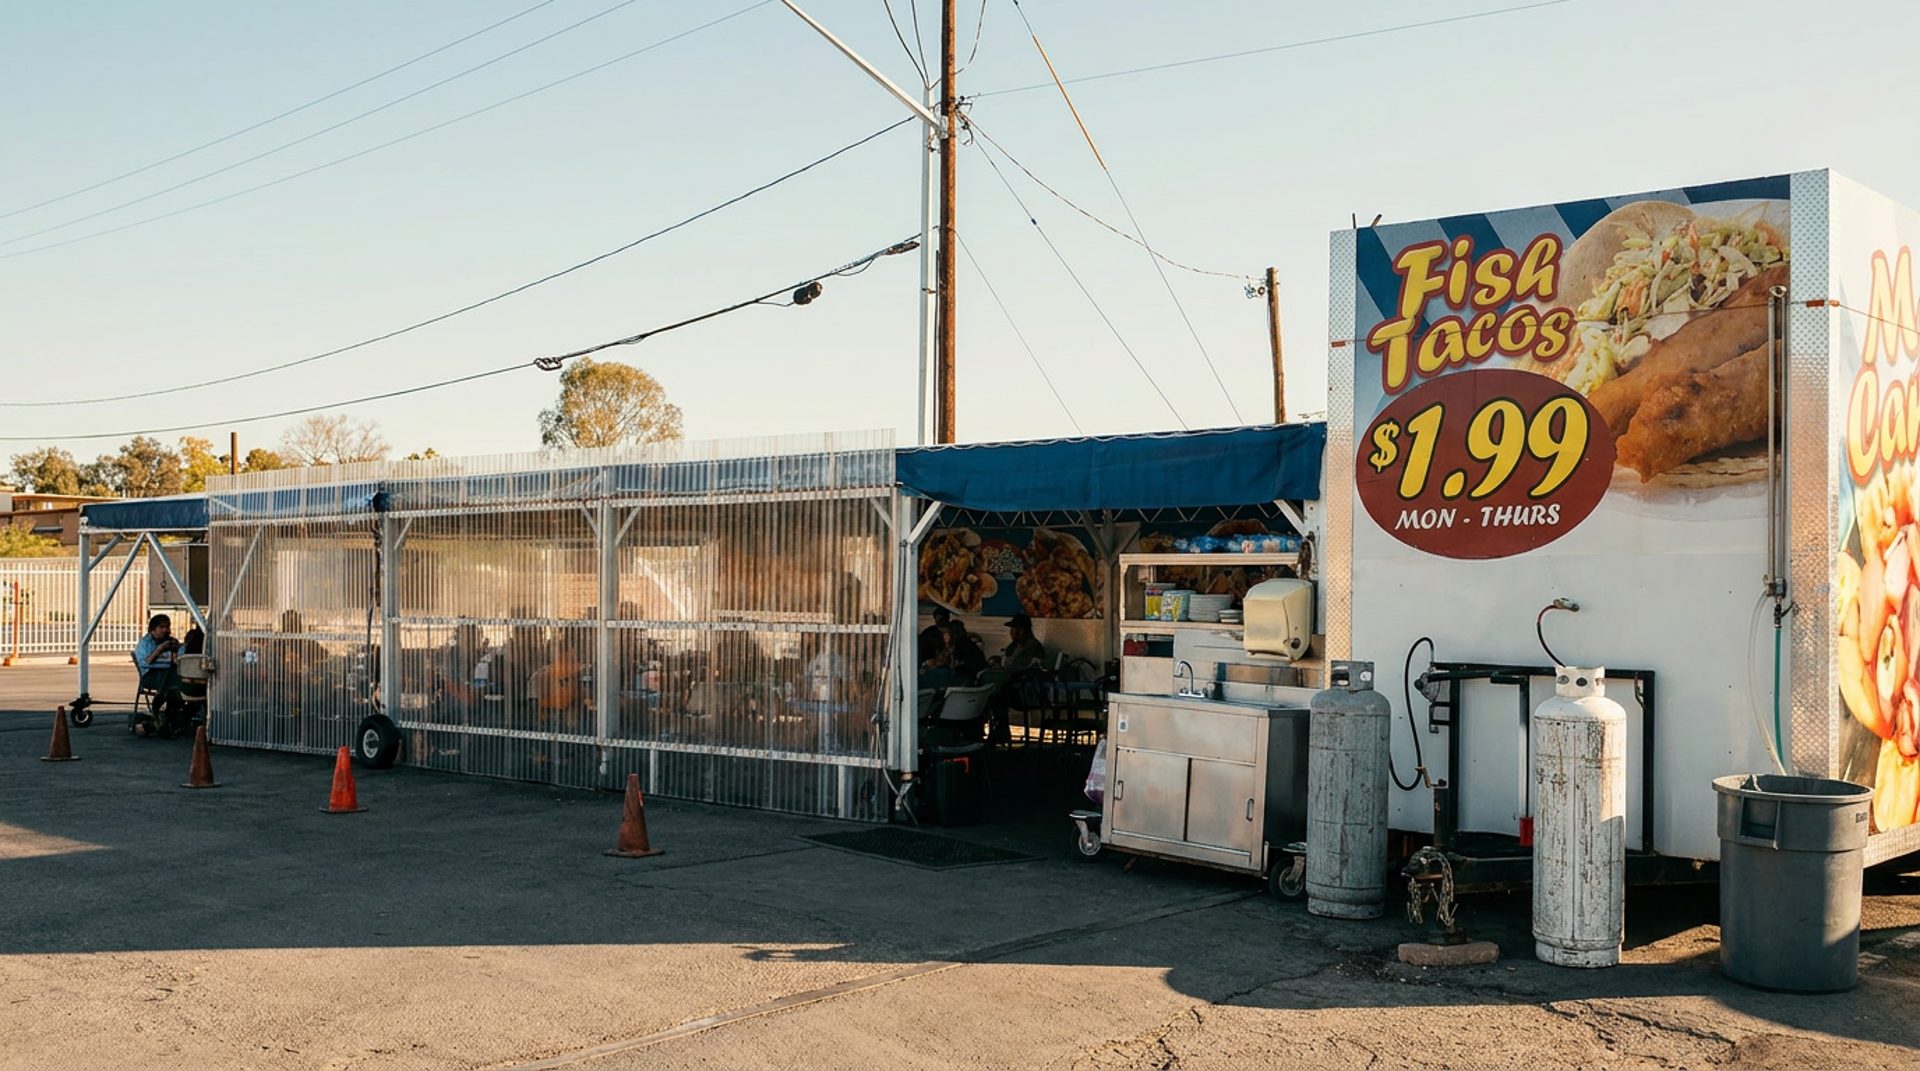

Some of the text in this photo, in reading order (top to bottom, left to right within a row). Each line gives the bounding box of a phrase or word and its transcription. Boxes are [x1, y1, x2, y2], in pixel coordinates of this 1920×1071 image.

[1394, 234, 1562, 319] Fish
[1367, 306, 1573, 394] Tacos
[1369, 396, 1588, 499] $1.99
[1395, 508, 1456, 530] MON
[1481, 503, 1561, 527] THURS
